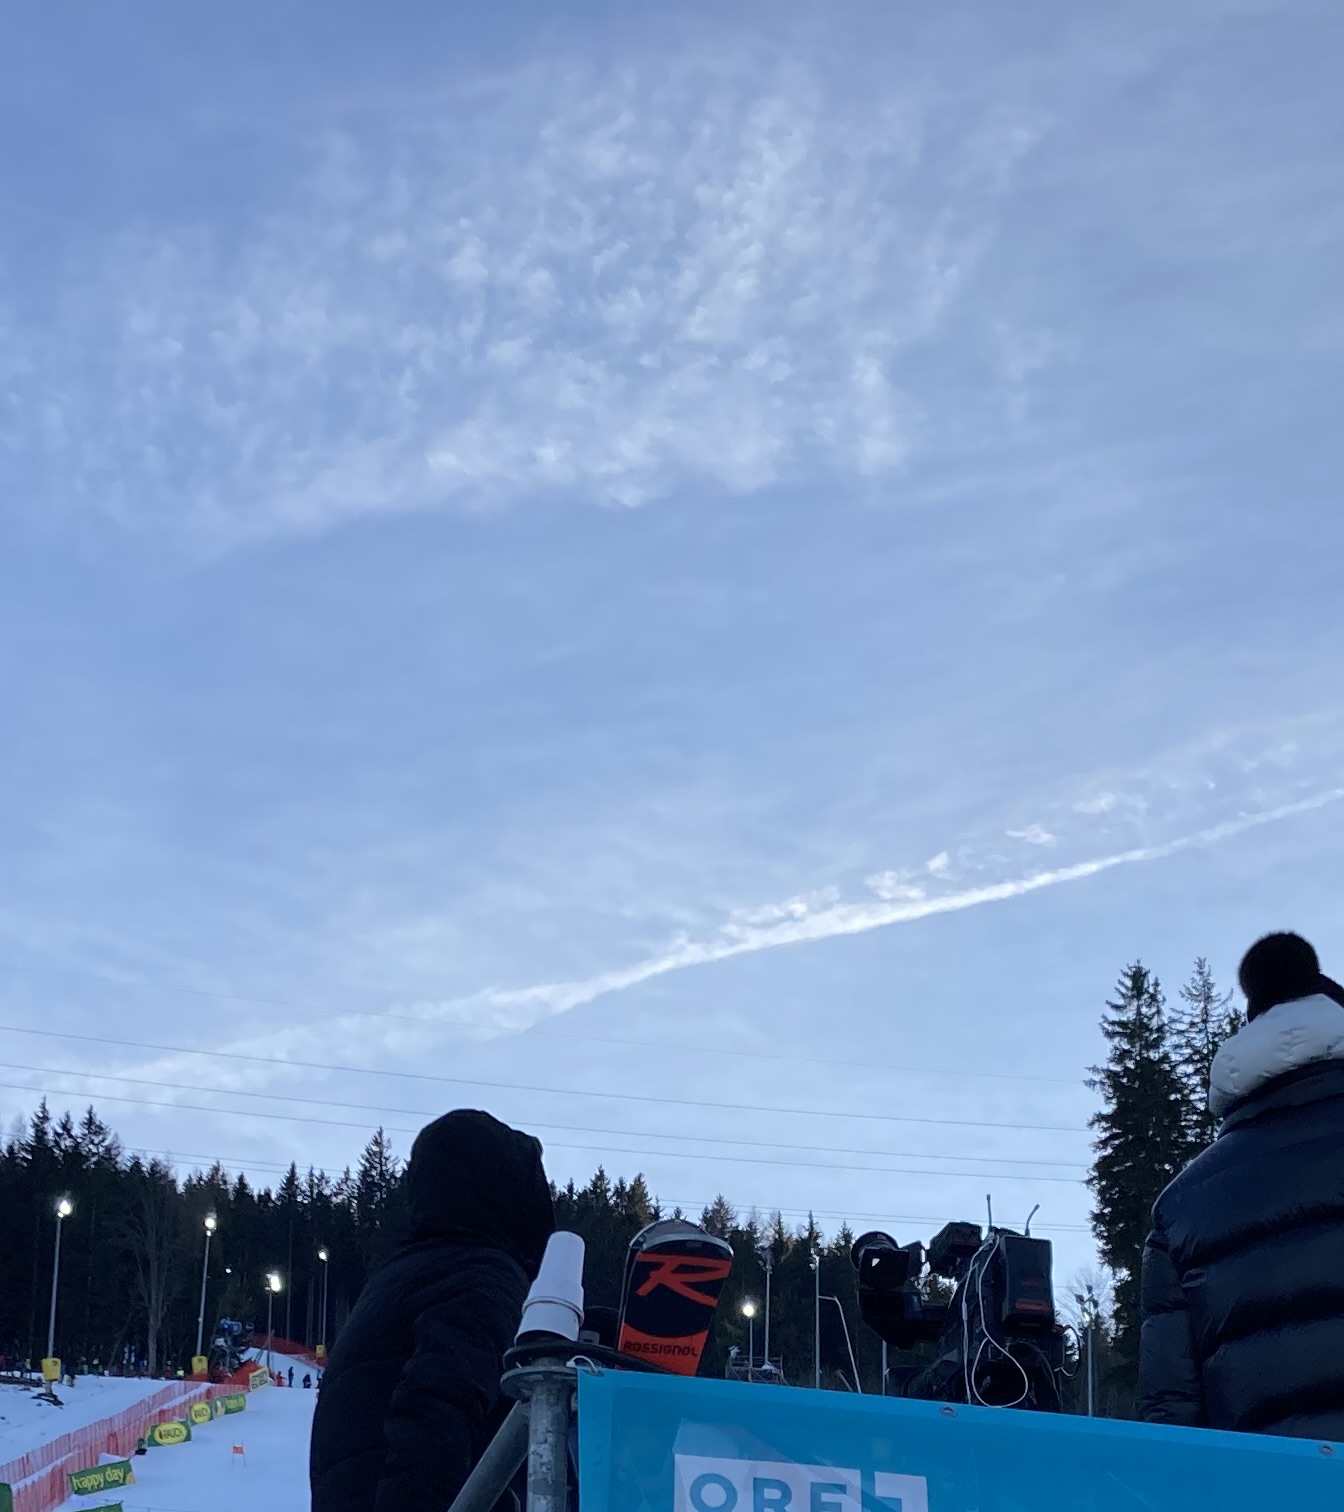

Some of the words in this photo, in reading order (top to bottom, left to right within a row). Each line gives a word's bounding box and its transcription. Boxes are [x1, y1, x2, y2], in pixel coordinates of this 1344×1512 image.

[622, 1340, 698, 1358] ROSSIGNOL
[71, 1472, 105, 1491] happy
[105, 1466, 124, 1484] day
